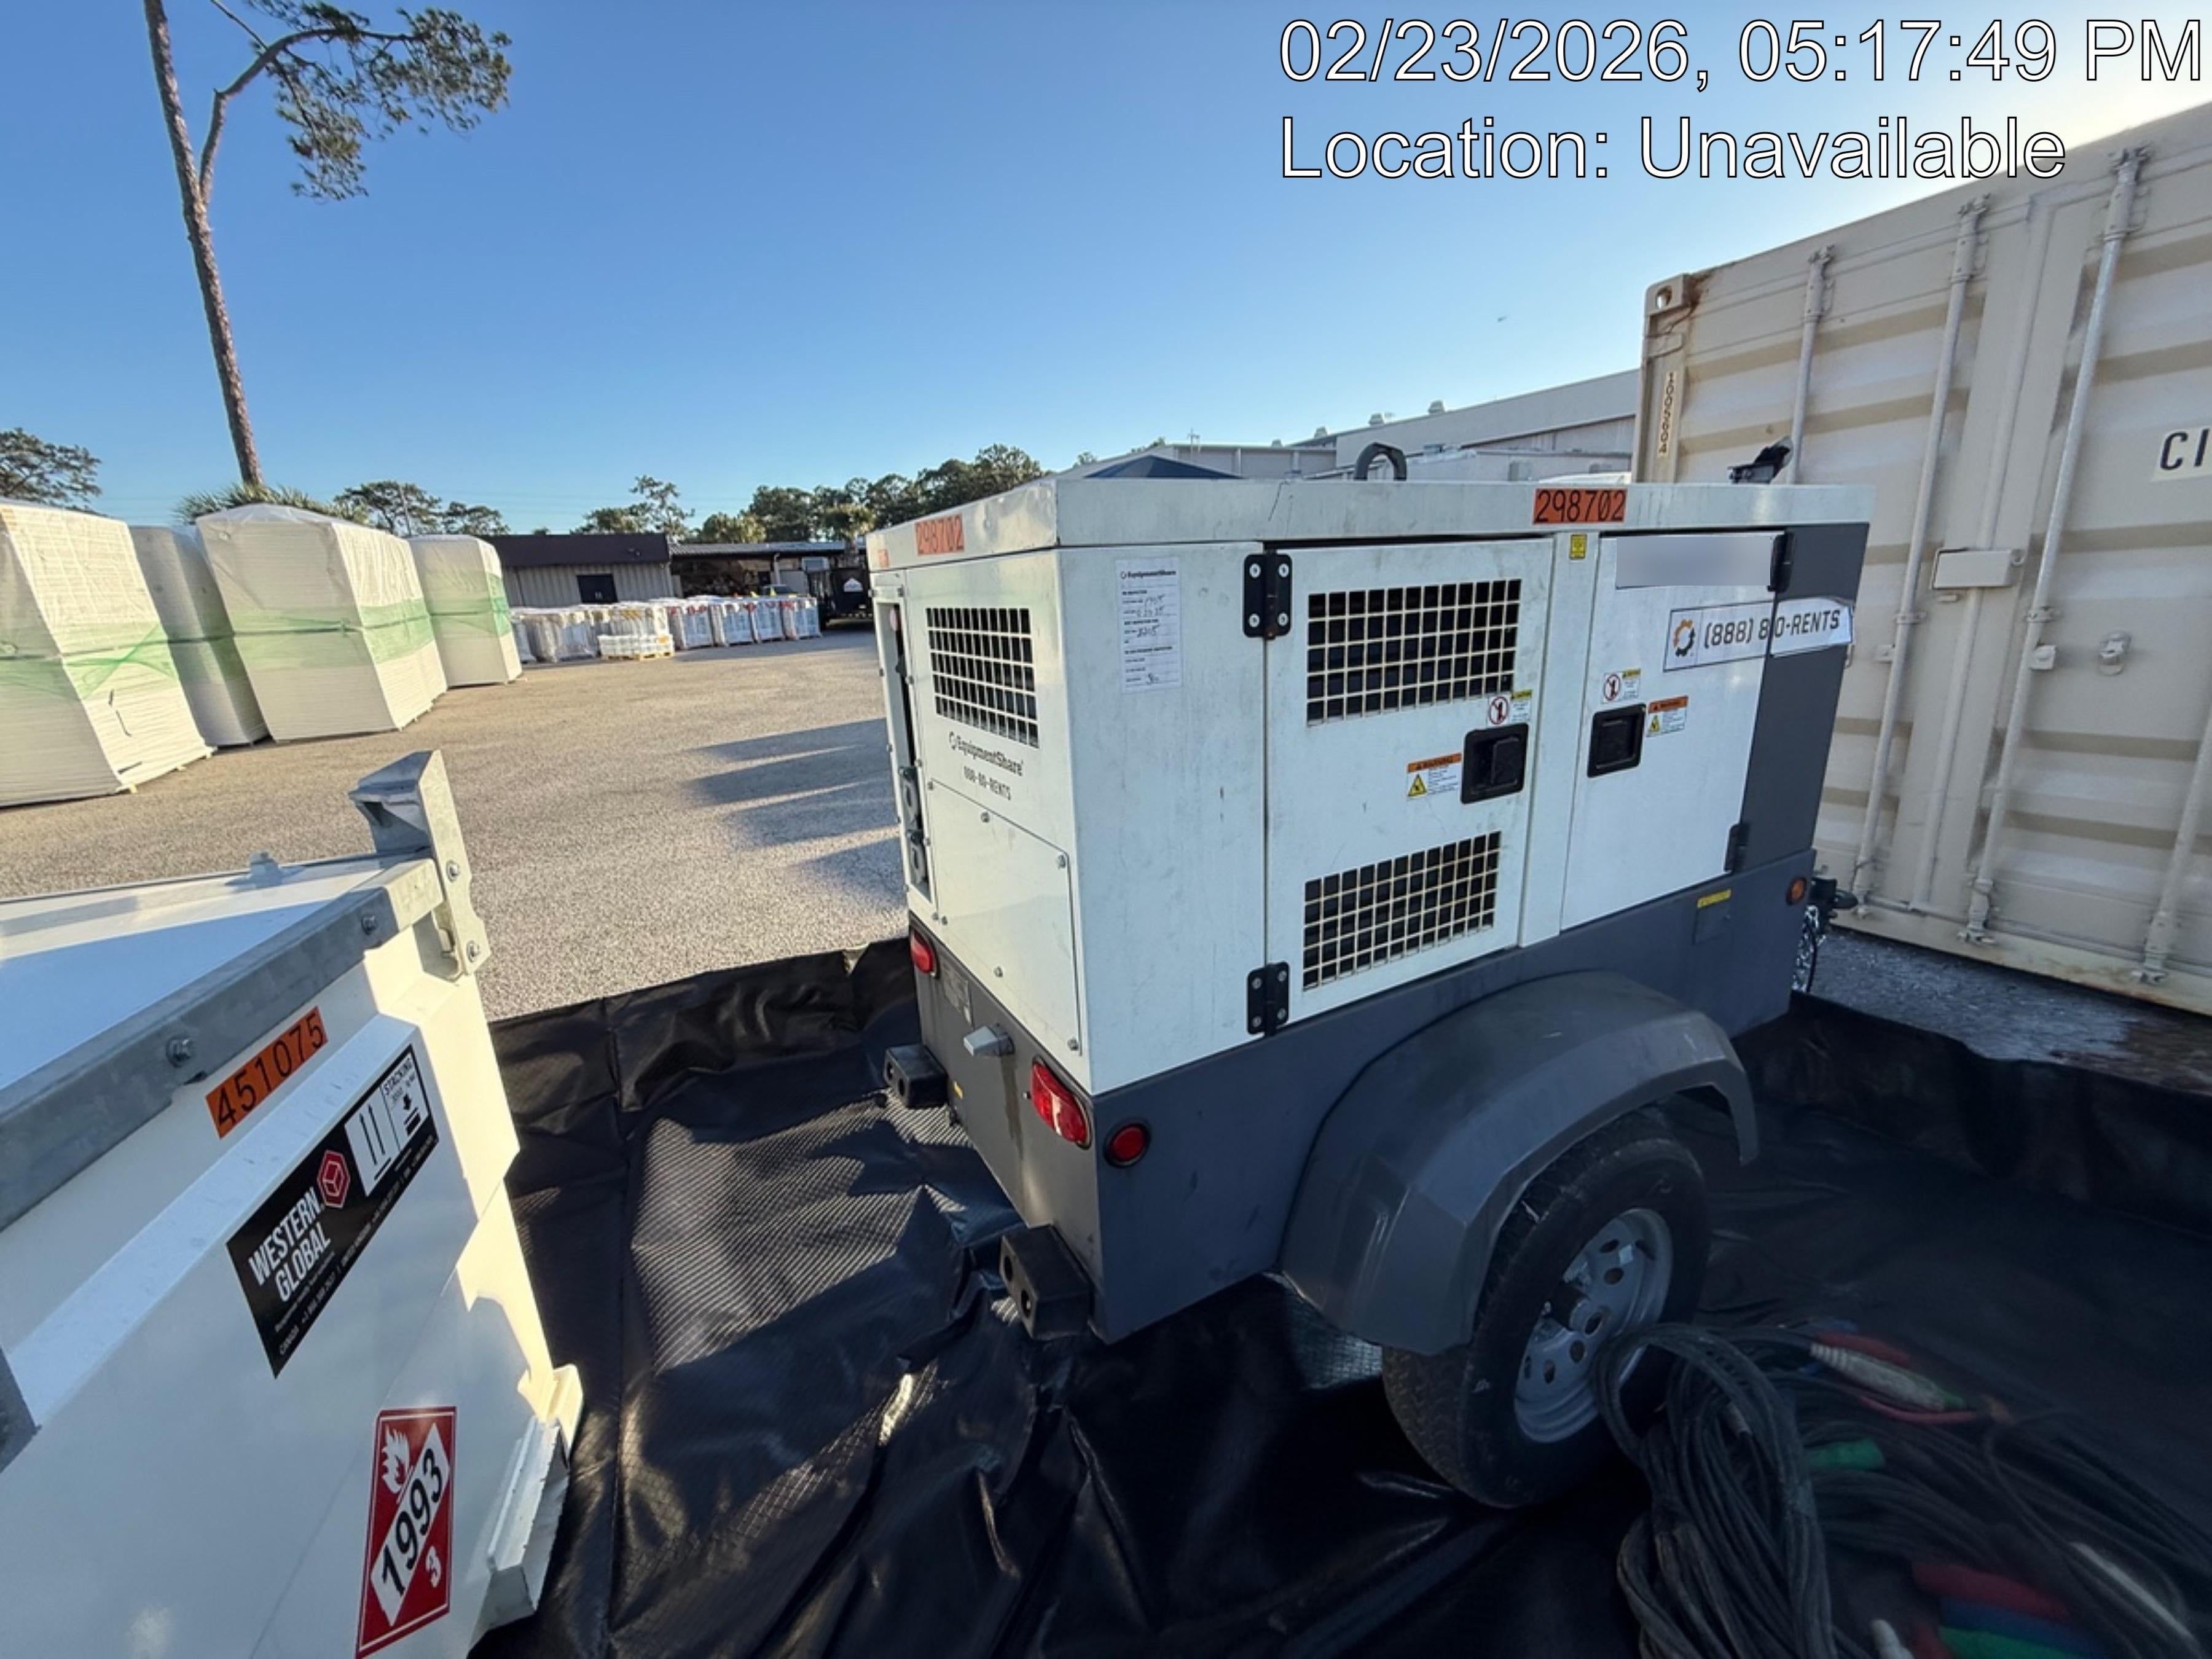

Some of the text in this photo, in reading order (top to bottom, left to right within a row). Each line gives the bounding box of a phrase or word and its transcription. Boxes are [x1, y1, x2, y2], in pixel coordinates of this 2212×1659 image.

[914, 516, 965, 554] 298702
[1535, 489, 1626, 523] 298702
[1704, 619, 1754, 649] (888)
[218, 1013, 324, 1126] 451075
[248, 1186, 322, 1287] WESTERN
[275, 1221, 331, 1303] GLOBAL
[381, 1448, 443, 1598] 1993
[425, 1546, 442, 1589] 3
